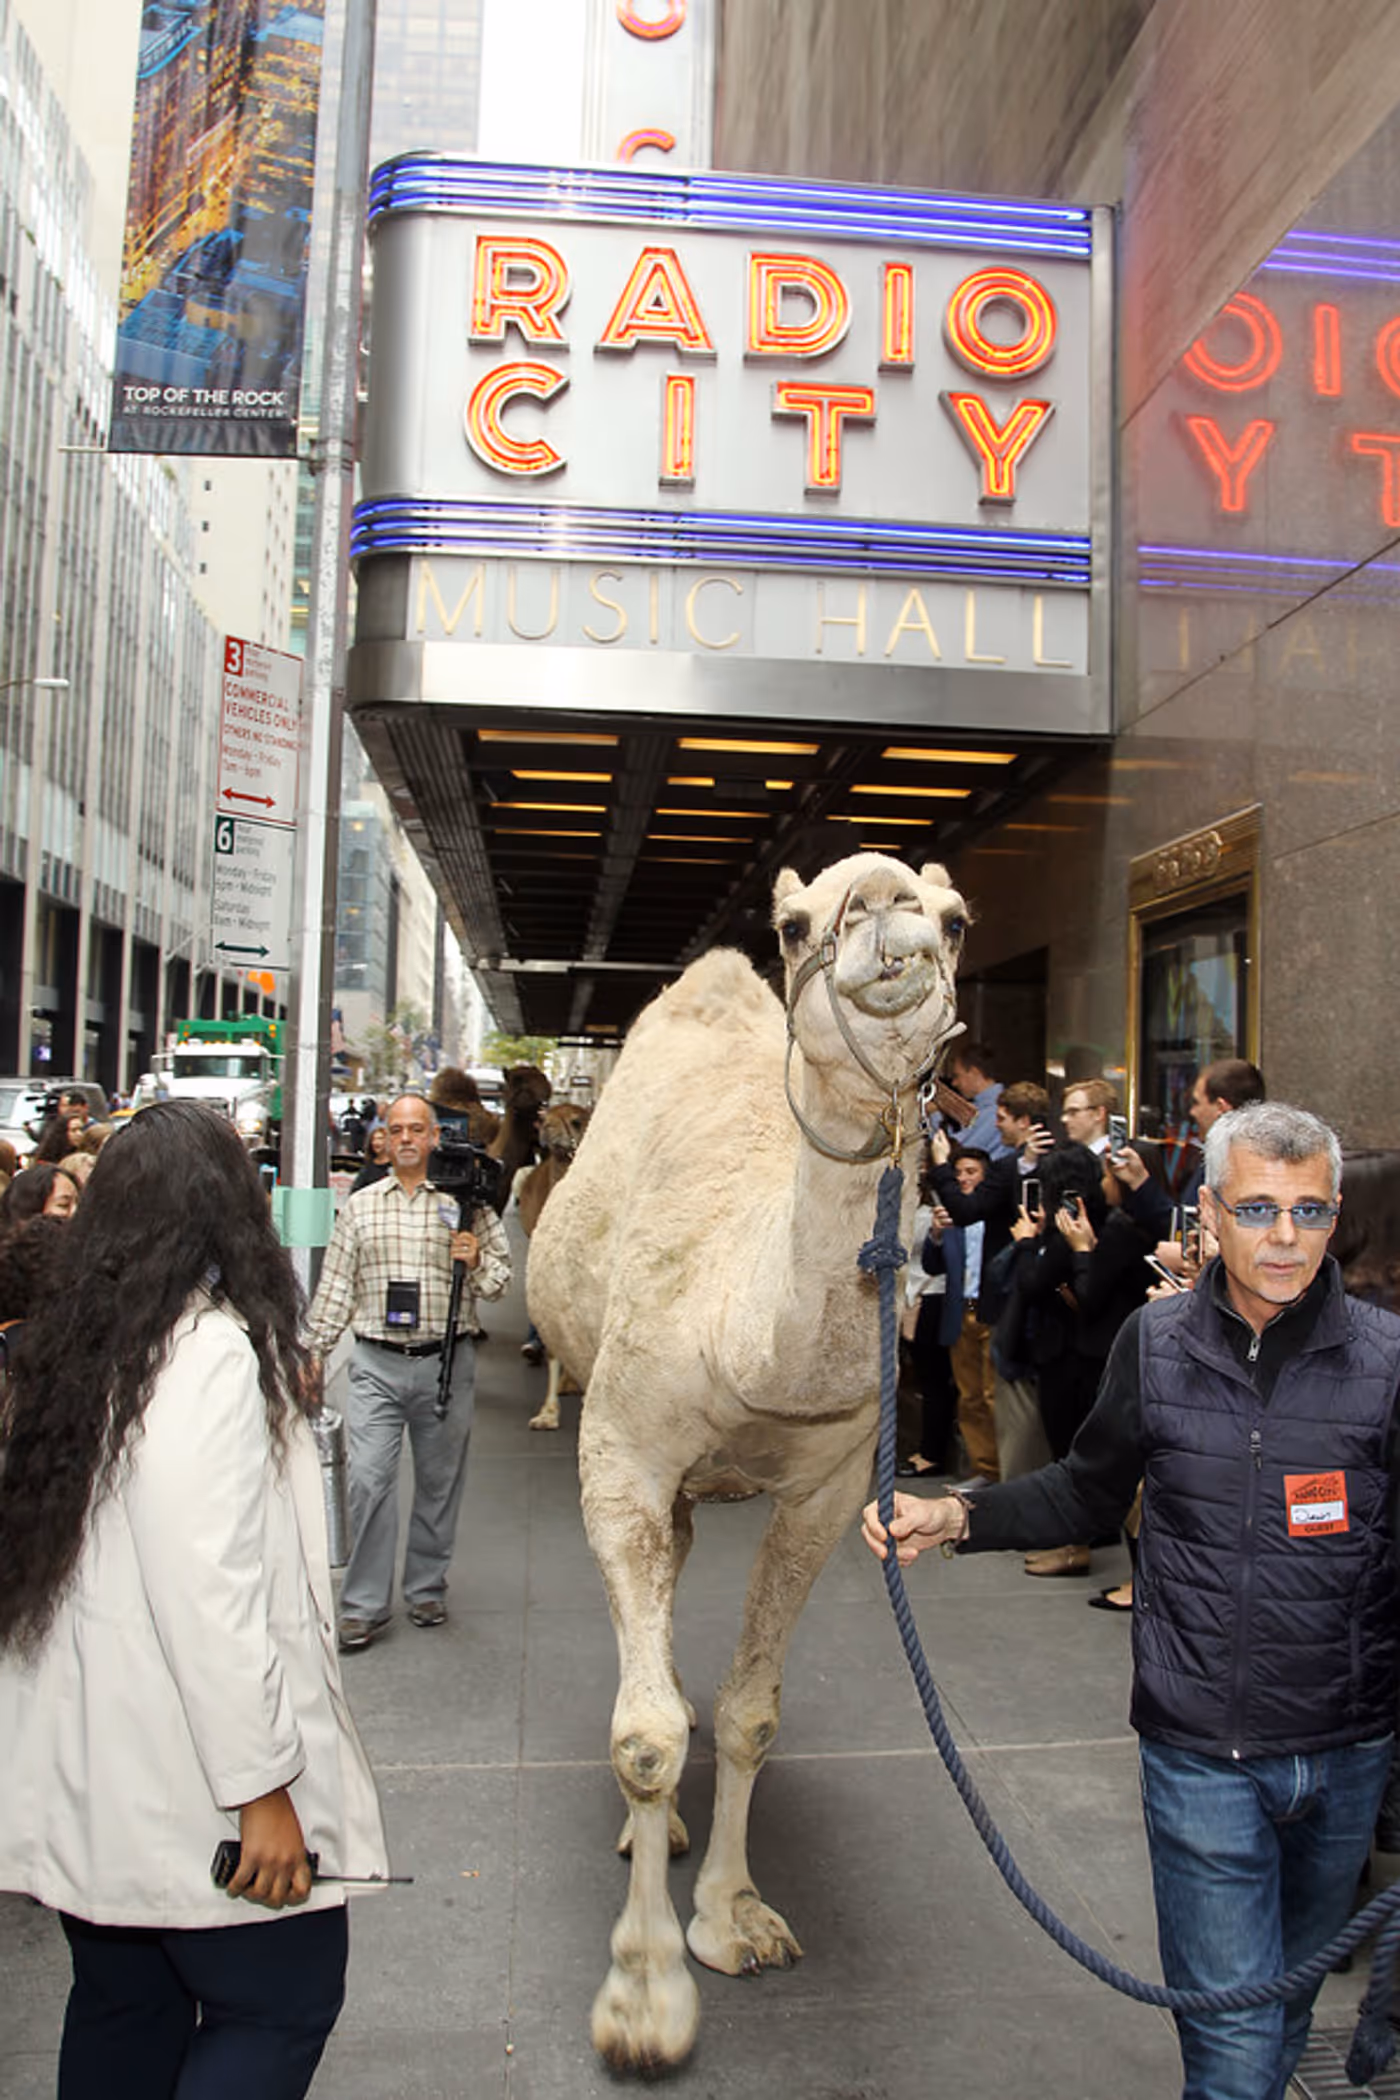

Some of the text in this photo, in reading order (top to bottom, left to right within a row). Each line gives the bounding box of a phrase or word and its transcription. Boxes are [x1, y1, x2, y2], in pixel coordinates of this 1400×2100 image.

[467, 234, 1057, 382] RADIO
[123, 386, 285, 406] TOP OF THE ROCK
[123, 406, 137, 414] AT
[143, 406, 231, 417] ROCKEFELLER
[464, 357, 1056, 506] CITY
[415, 560, 744, 650] MUSIC
[816, 578, 1073, 669] HALL
[227, 641, 242, 672] 3
[226, 681, 289, 712] COMMERCIAL
[226, 701, 298, 731] VEHICLES ONLY
[217, 820, 231, 851] 6
[217, 864, 247, 880] Monday
